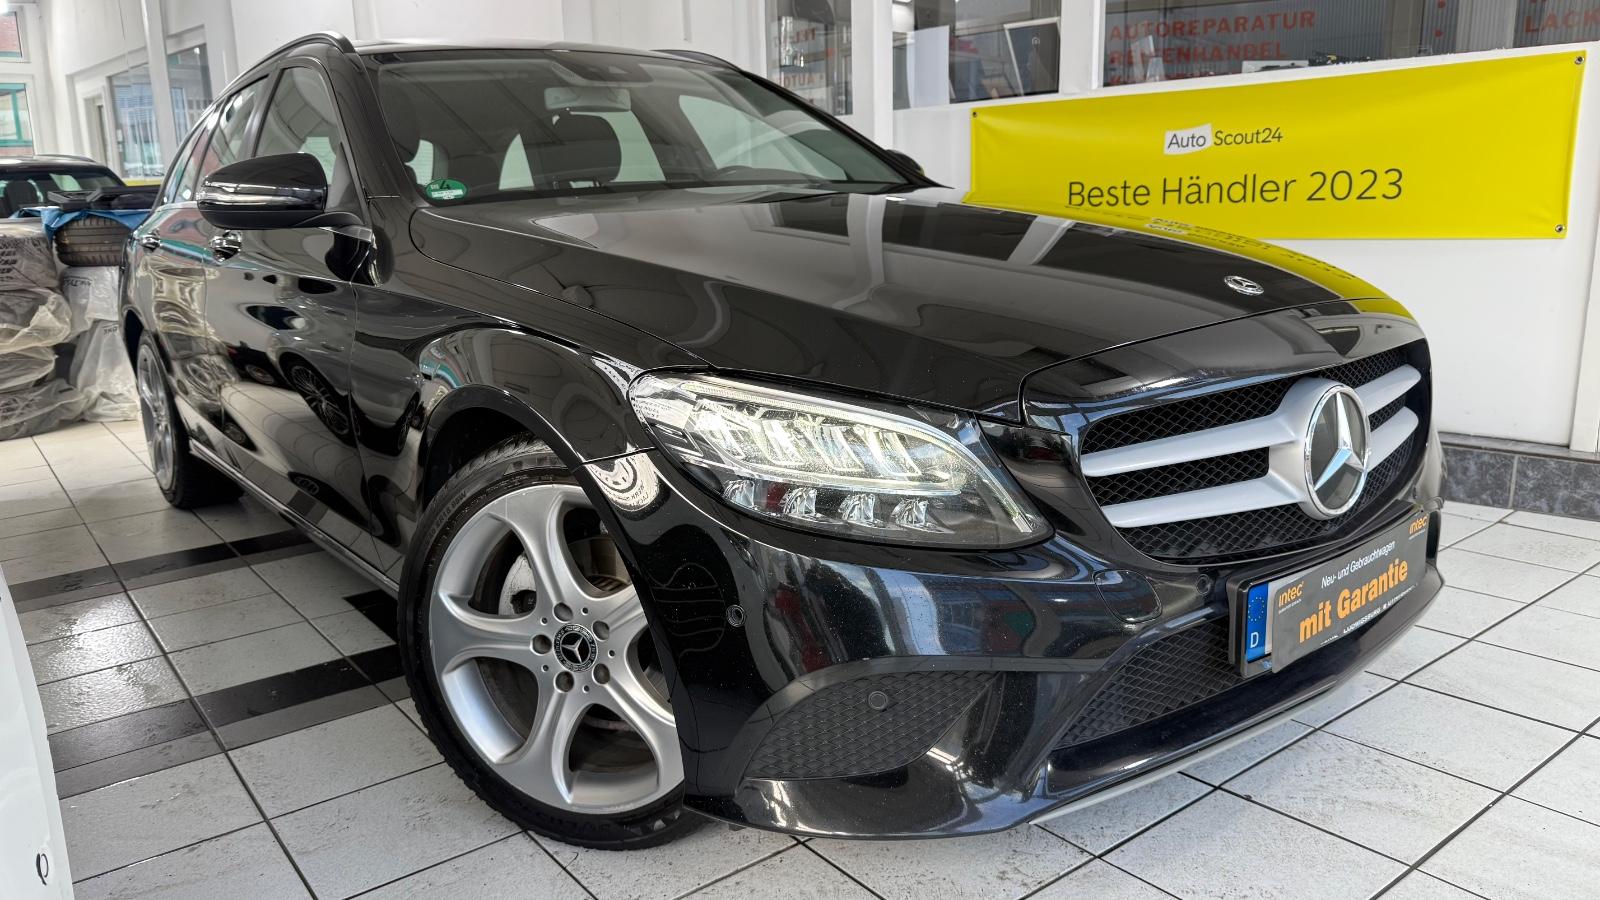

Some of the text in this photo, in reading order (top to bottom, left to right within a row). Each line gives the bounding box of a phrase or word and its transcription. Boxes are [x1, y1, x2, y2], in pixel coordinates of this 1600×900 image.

[1109, 10, 1317, 41] AUTOREPARATUR
[1167, 126, 1284, 150] Auto Scout24
[1067, 168, 1404, 208] Beste Händler 2023
[1321, 540, 1396, 589] Neu- und Gebrauchtwagen
[1299, 600, 1332, 643] mit
[1336, 558, 1409, 619] Garantie
[1250, 631, 1260, 649] D
